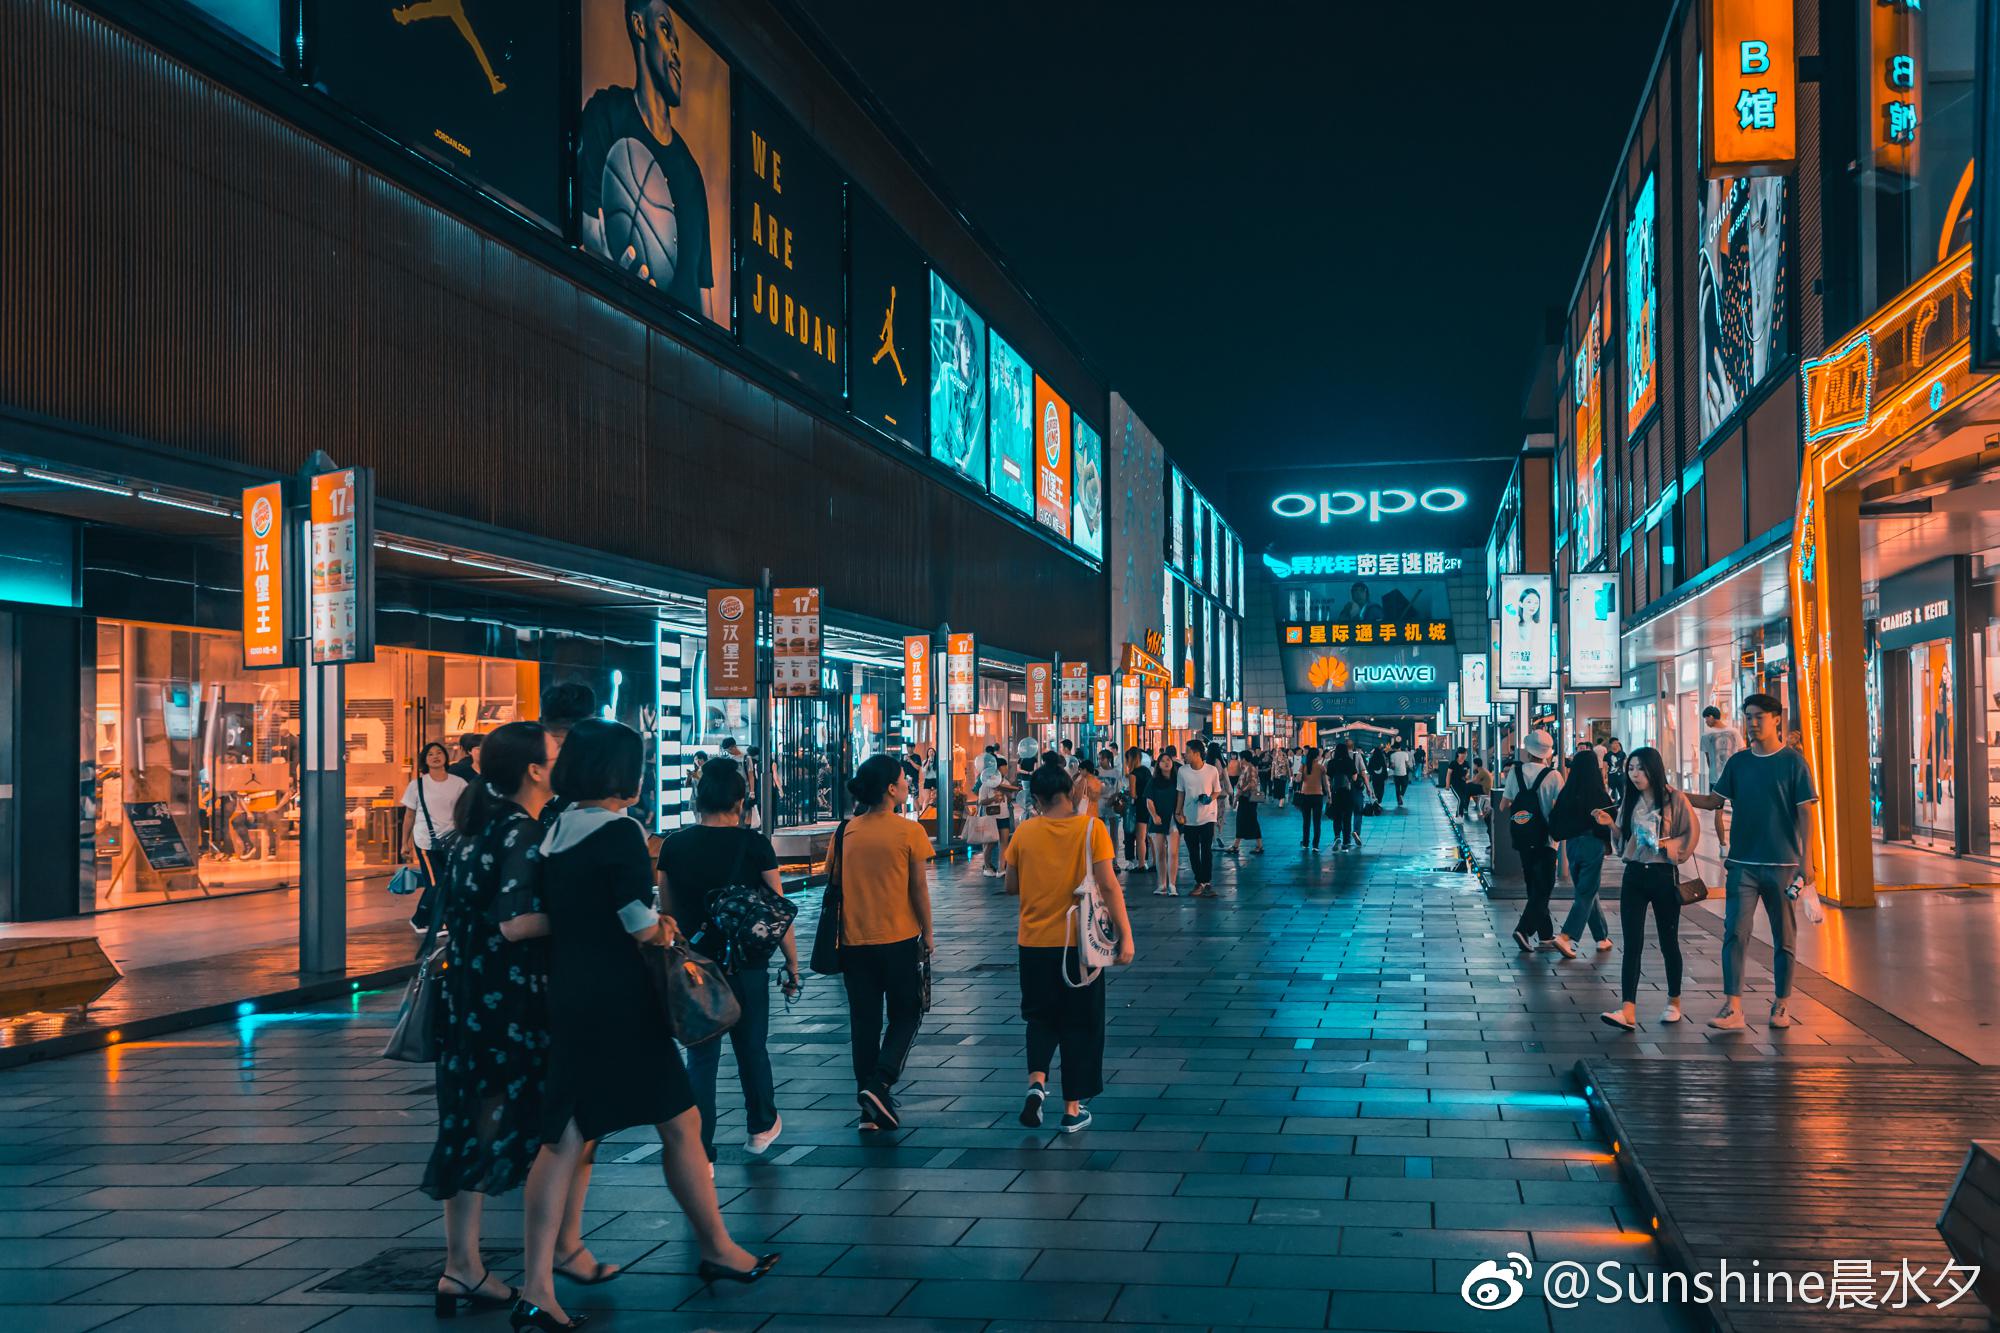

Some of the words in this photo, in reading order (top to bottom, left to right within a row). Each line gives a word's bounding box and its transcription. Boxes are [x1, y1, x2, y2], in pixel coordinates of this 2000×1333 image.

[1737, 41, 1777, 129] B馆
[434, 129, 471, 158] JORDAN.COM
[752, 131, 782, 194] WE
[753, 202, 793, 270] ARE
[1709, 181, 1738, 243] CHARLES
[753, 273, 837, 364] JORDAN
[329, 487, 347, 516] 17
[1041, 465, 1064, 510] 汉堡王
[254, 543, 271, 634] 汉堡王
[792, 597, 810, 613] 17
[1309, 622, 1447, 644] 星际通手机城
[1880, 609, 1912, 632] CHARLES
[1915, 607, 1922, 624] &
[1924, 600, 1948, 621] KEITH
[722, 624, 740, 678] 汉堡王
[1354, 666, 1435, 682] HUAWEI
